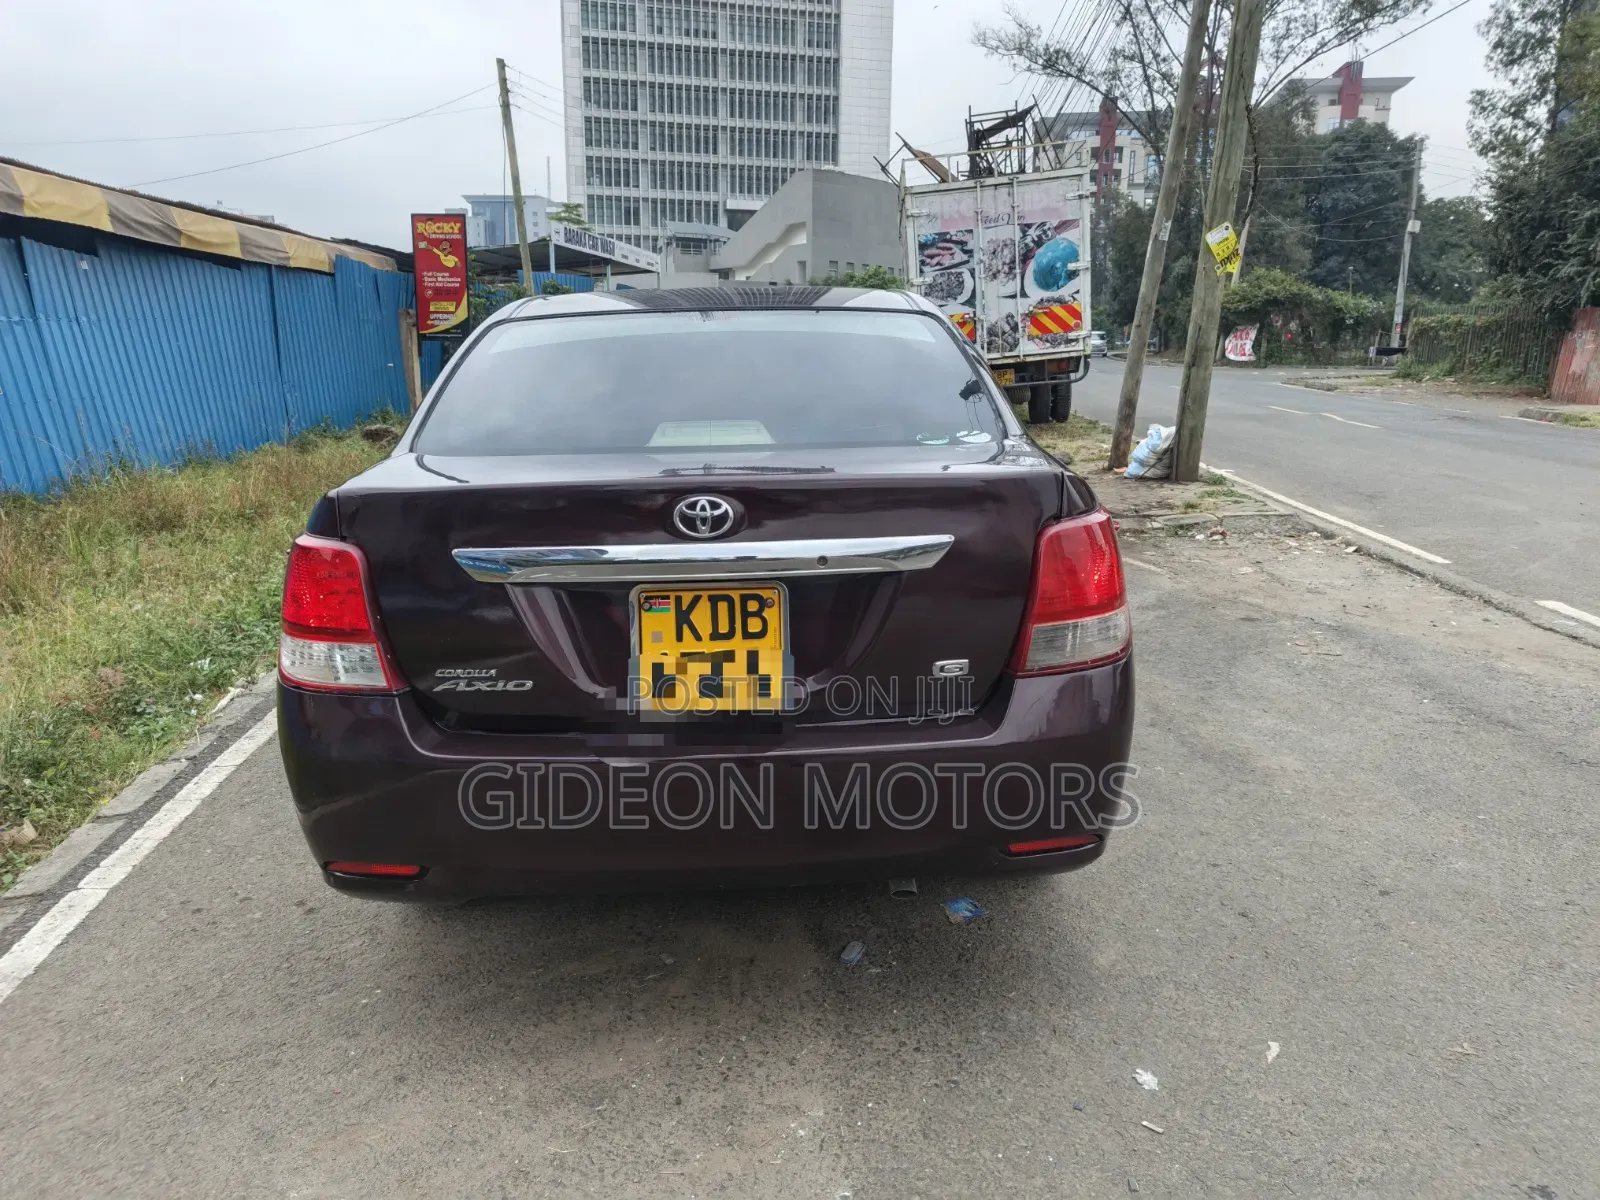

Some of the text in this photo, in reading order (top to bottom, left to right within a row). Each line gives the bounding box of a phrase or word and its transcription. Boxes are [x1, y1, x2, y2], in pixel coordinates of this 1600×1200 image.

[416, 221, 461, 236] ROCKY
[564, 226, 588, 250] BARAKA
[675, 593, 769, 643] KDB
[435, 668, 498, 678] COROLLA
